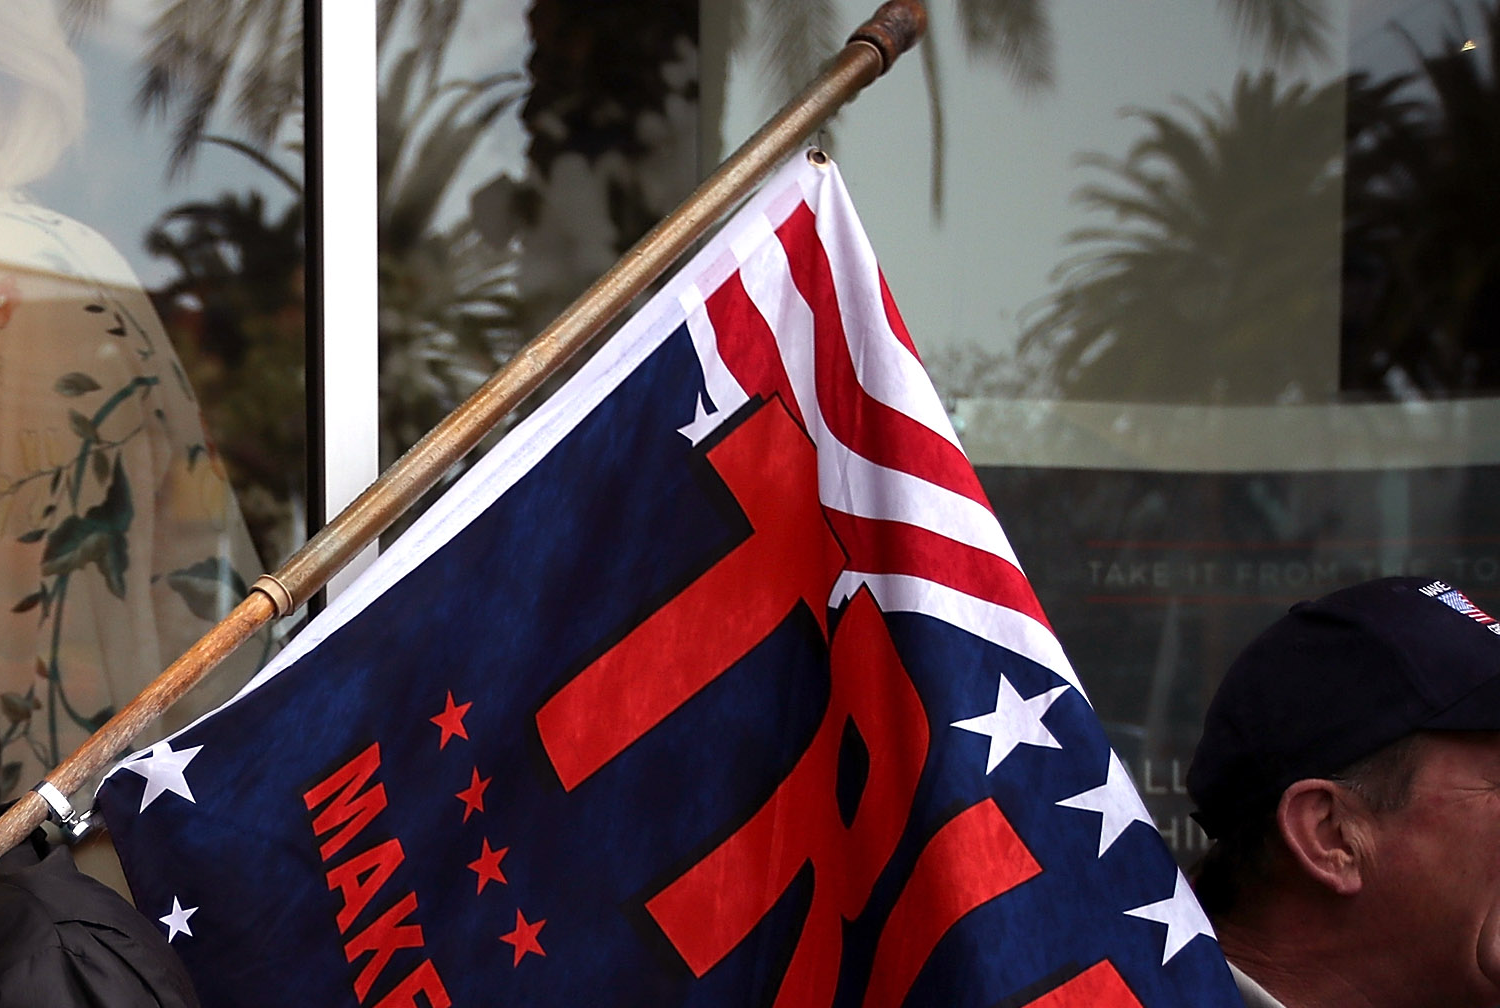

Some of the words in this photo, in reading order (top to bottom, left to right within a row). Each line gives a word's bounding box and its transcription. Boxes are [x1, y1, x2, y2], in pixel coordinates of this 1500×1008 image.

[1086, 560, 1172, 586] TAKE
[1189, 560, 1216, 584] IT
[1237, 559, 1336, 585] FROM
